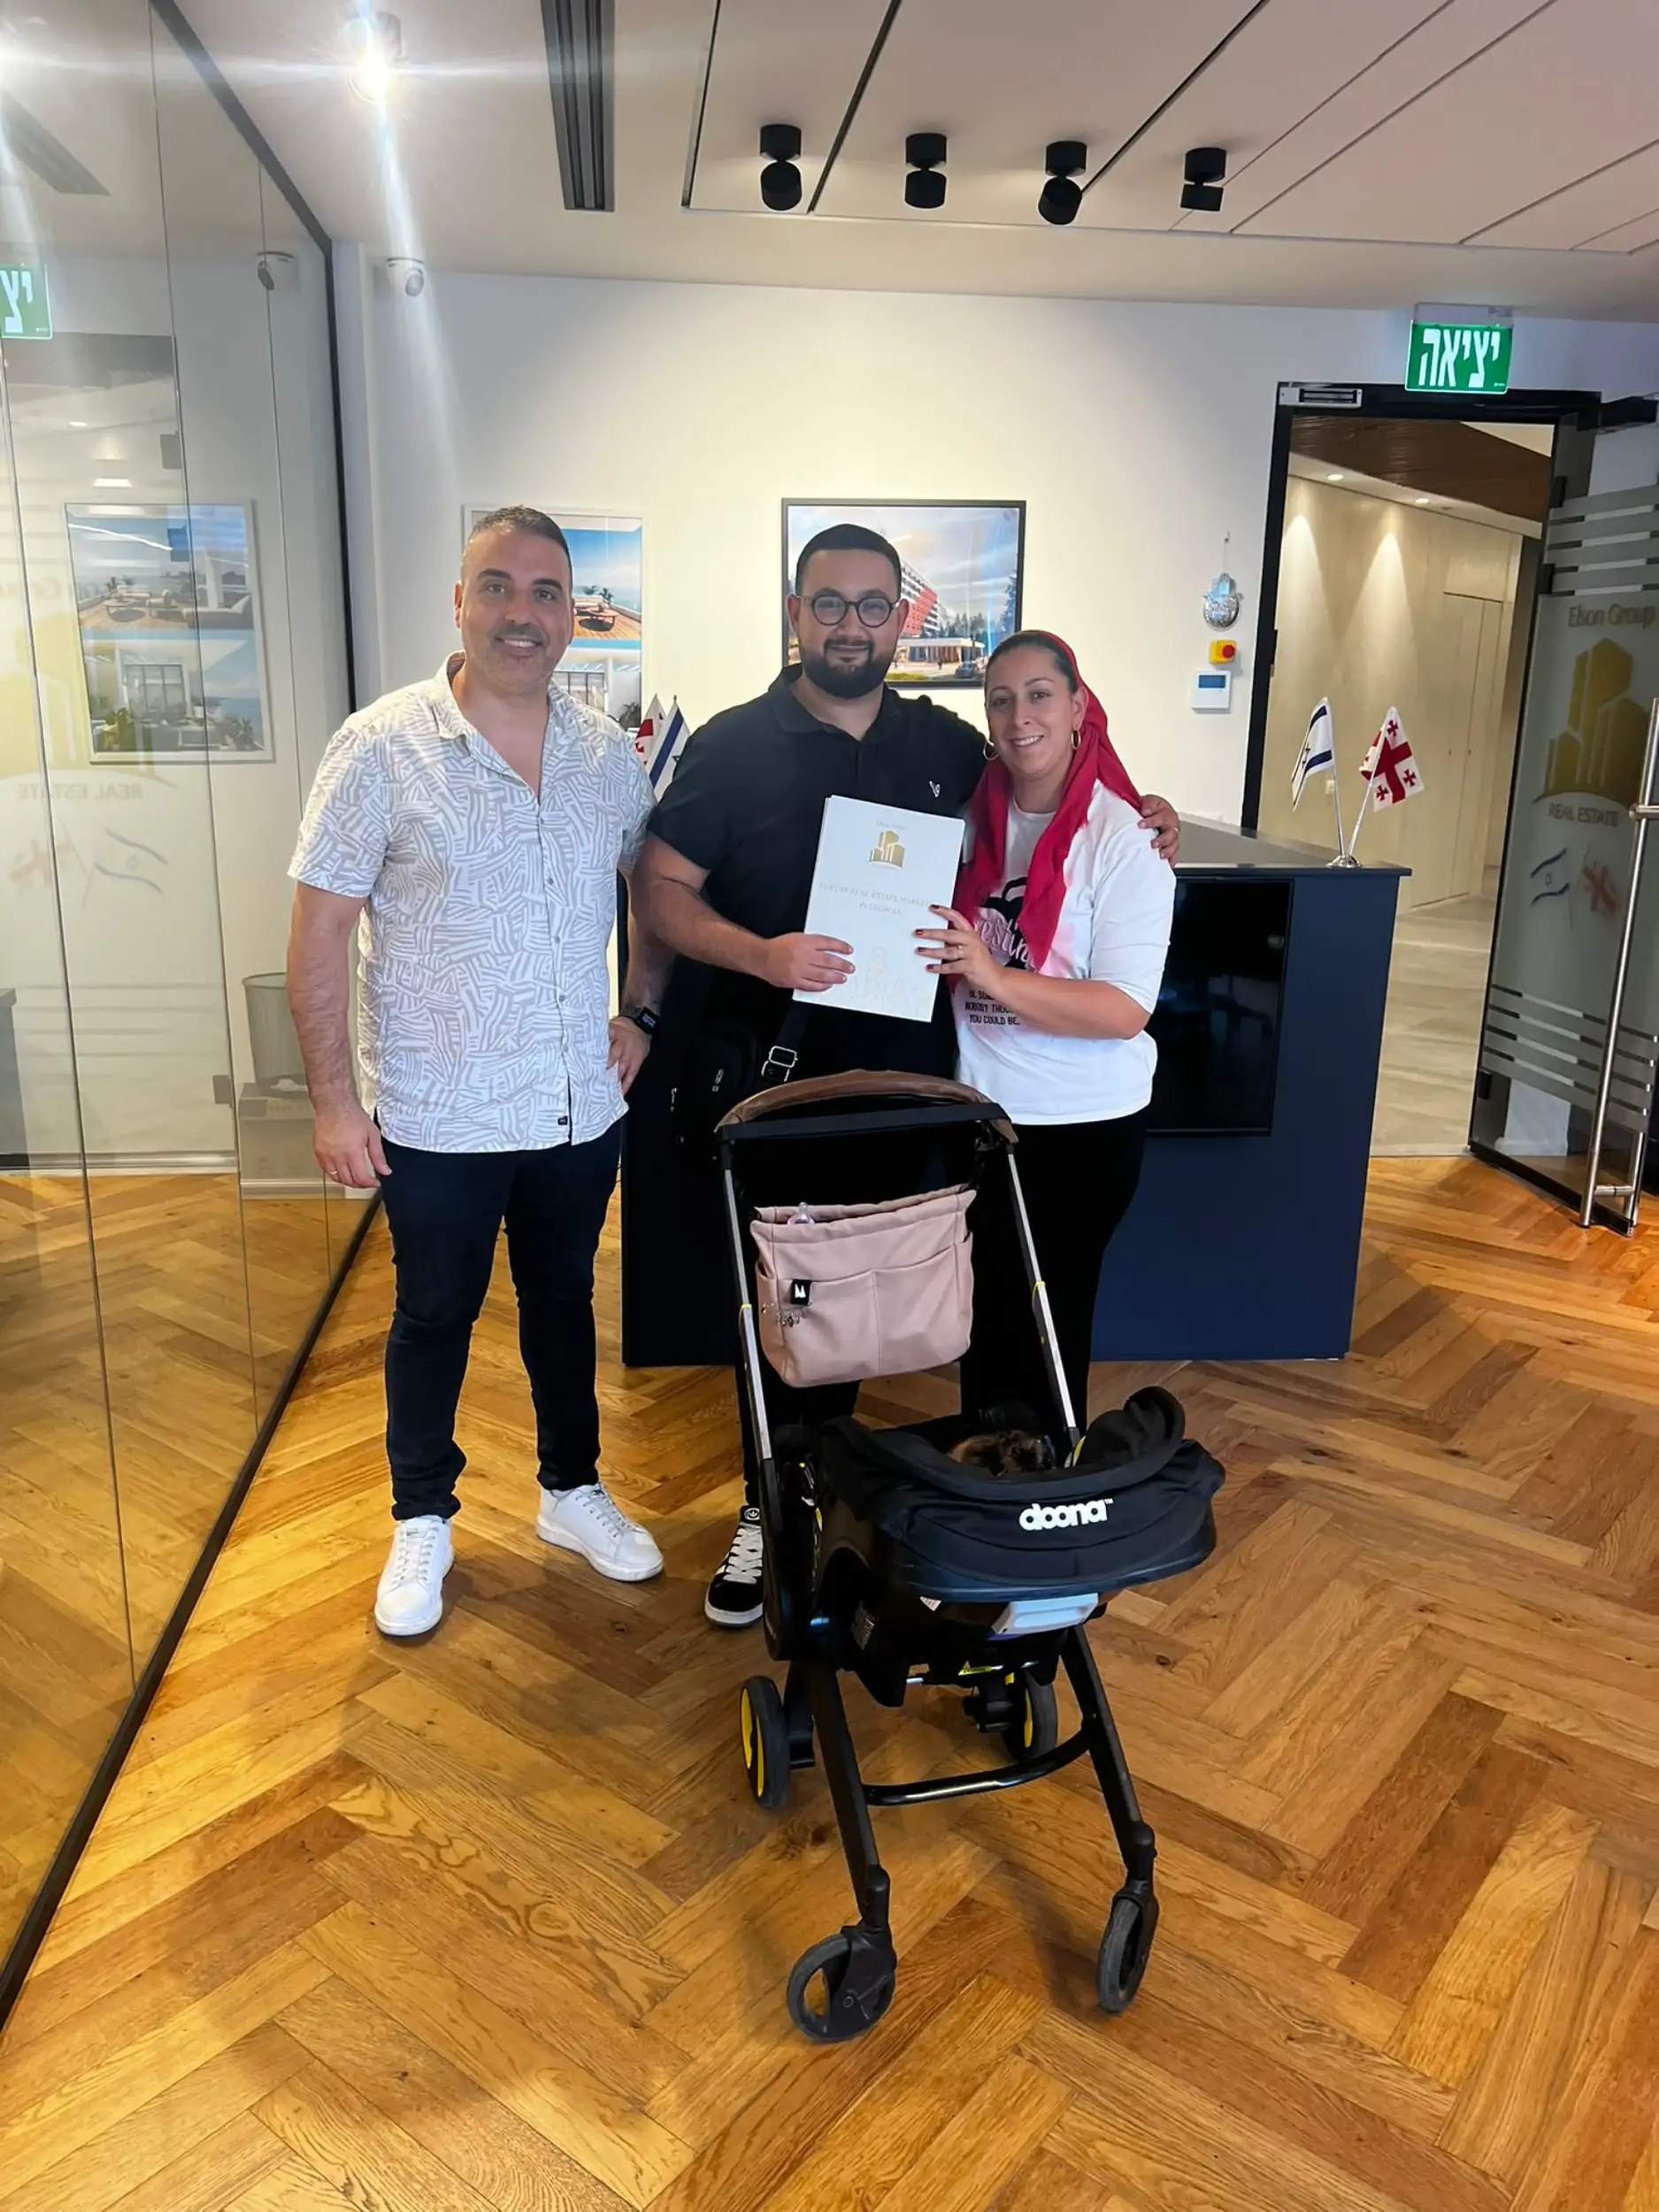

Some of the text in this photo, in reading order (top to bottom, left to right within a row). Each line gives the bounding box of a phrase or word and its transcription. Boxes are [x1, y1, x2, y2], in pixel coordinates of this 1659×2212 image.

[1418, 328, 1501, 388] יציאה
[1548, 803, 1575, 820] REAL
[969, 1014, 982, 1024] YOU
[983, 1015, 1006, 1025] COULD
